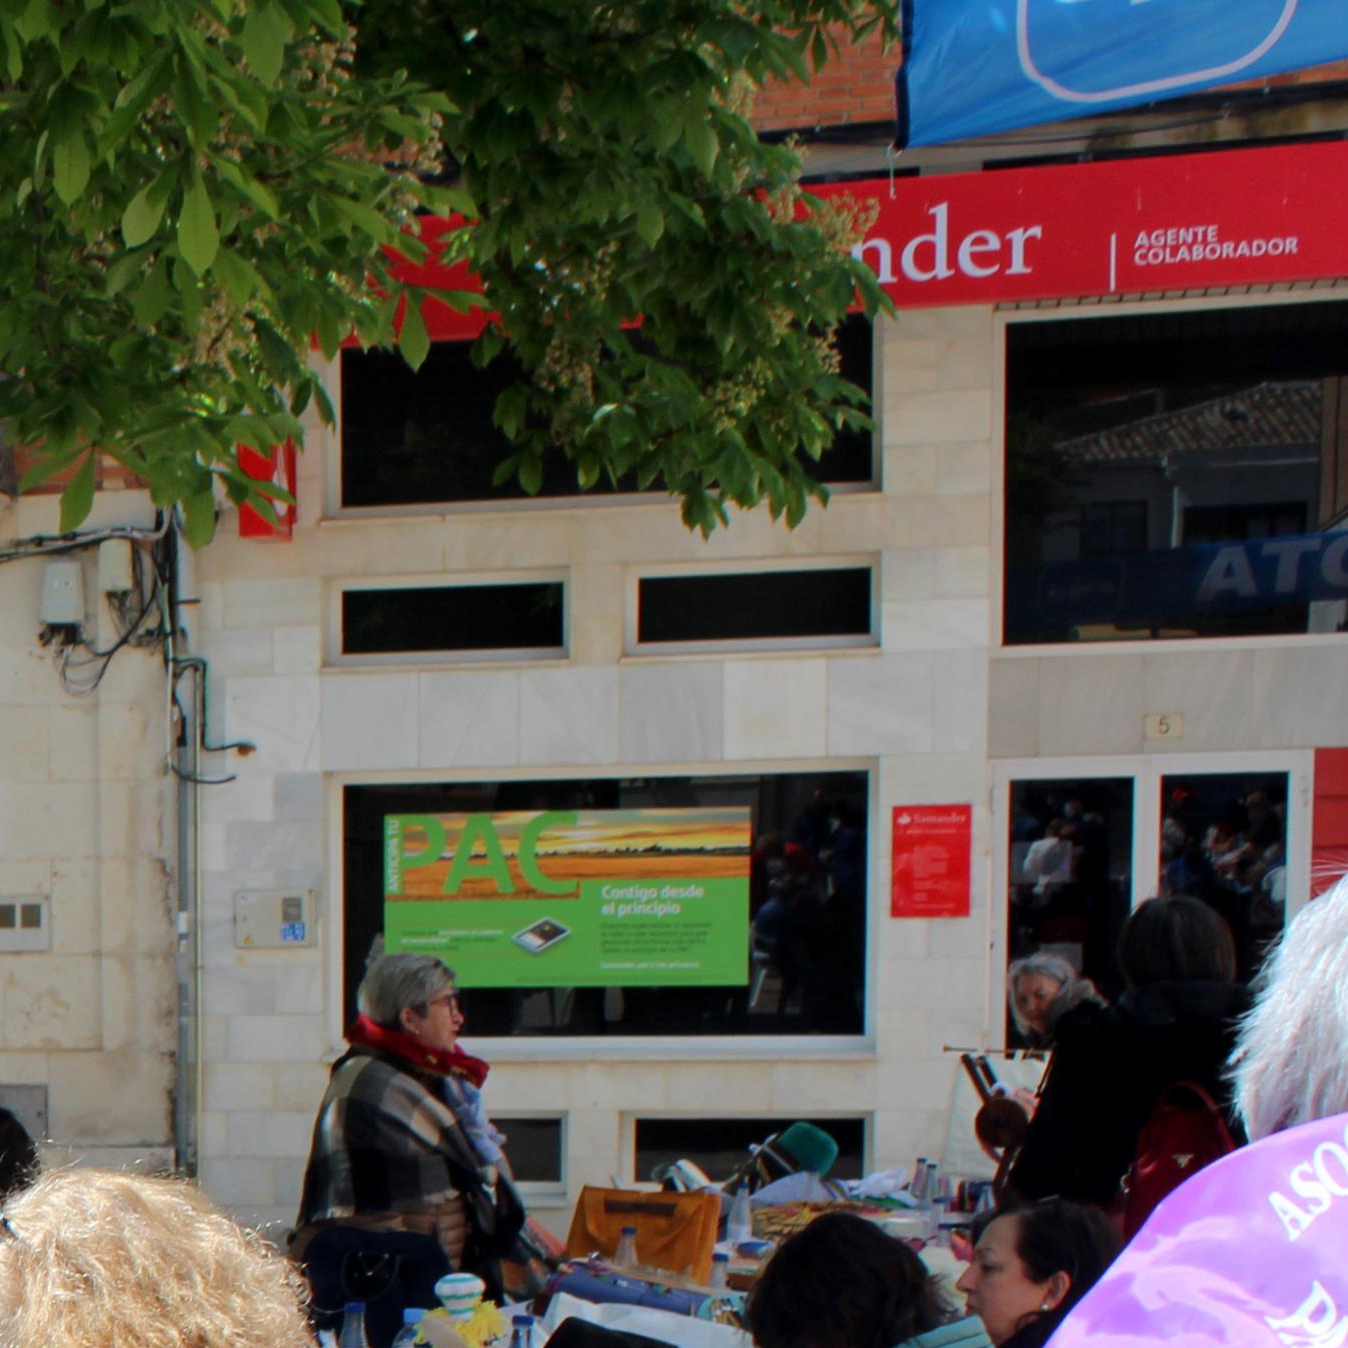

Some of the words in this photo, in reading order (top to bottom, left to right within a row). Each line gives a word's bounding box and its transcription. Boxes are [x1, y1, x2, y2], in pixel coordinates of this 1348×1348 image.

[1134, 225, 1218, 248] AGENTE
[1134, 236, 1299, 266] COLABORADOR
[399, 811, 578, 895] PAC
[600, 884, 658, 902] Contigo
[660, 884, 705, 899] desde
[600, 902, 615, 915] el
[617, 902, 682, 918] principio
[1268, 1123, 1348, 1242] ASO
